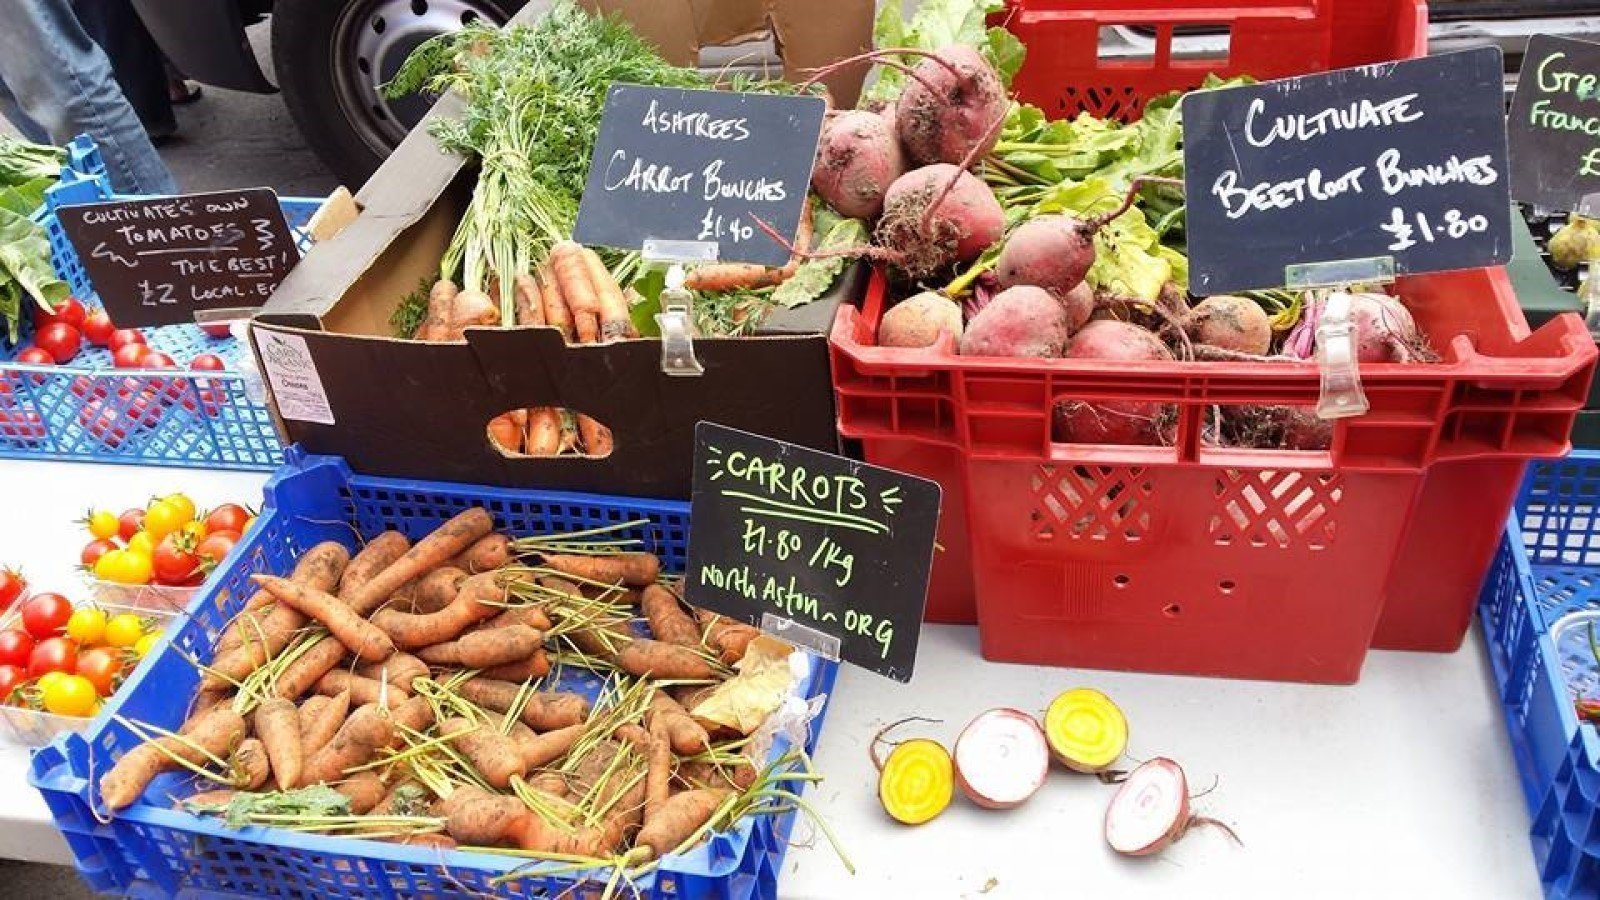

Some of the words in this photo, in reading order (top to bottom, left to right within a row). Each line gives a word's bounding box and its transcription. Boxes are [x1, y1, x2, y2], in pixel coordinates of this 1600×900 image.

[1537, 52, 1600, 102] Gre
[643, 100, 750, 140] ASHTREES
[1245, 93, 1424, 147] CULTIVATE
[1530, 99, 1600, 136] Franc
[604, 150, 693, 192] CARROT
[702, 159, 787, 200] BUNCHES
[1212, 166, 1366, 218] BEETROOT
[1376, 148, 1498, 195] BUNCHES
[205, 197, 249, 213] OWN
[698, 207, 753, 243] £1.40
[117, 223, 246, 246] TOMATOES
[1380, 207, 1489, 251] £1.80
[172, 259, 220, 276] THE
[138, 279, 178, 306] £2
[727, 452, 868, 514] CARROTS
[742, 519, 801, 561] £1.80
[844, 609, 893, 659] ORG
